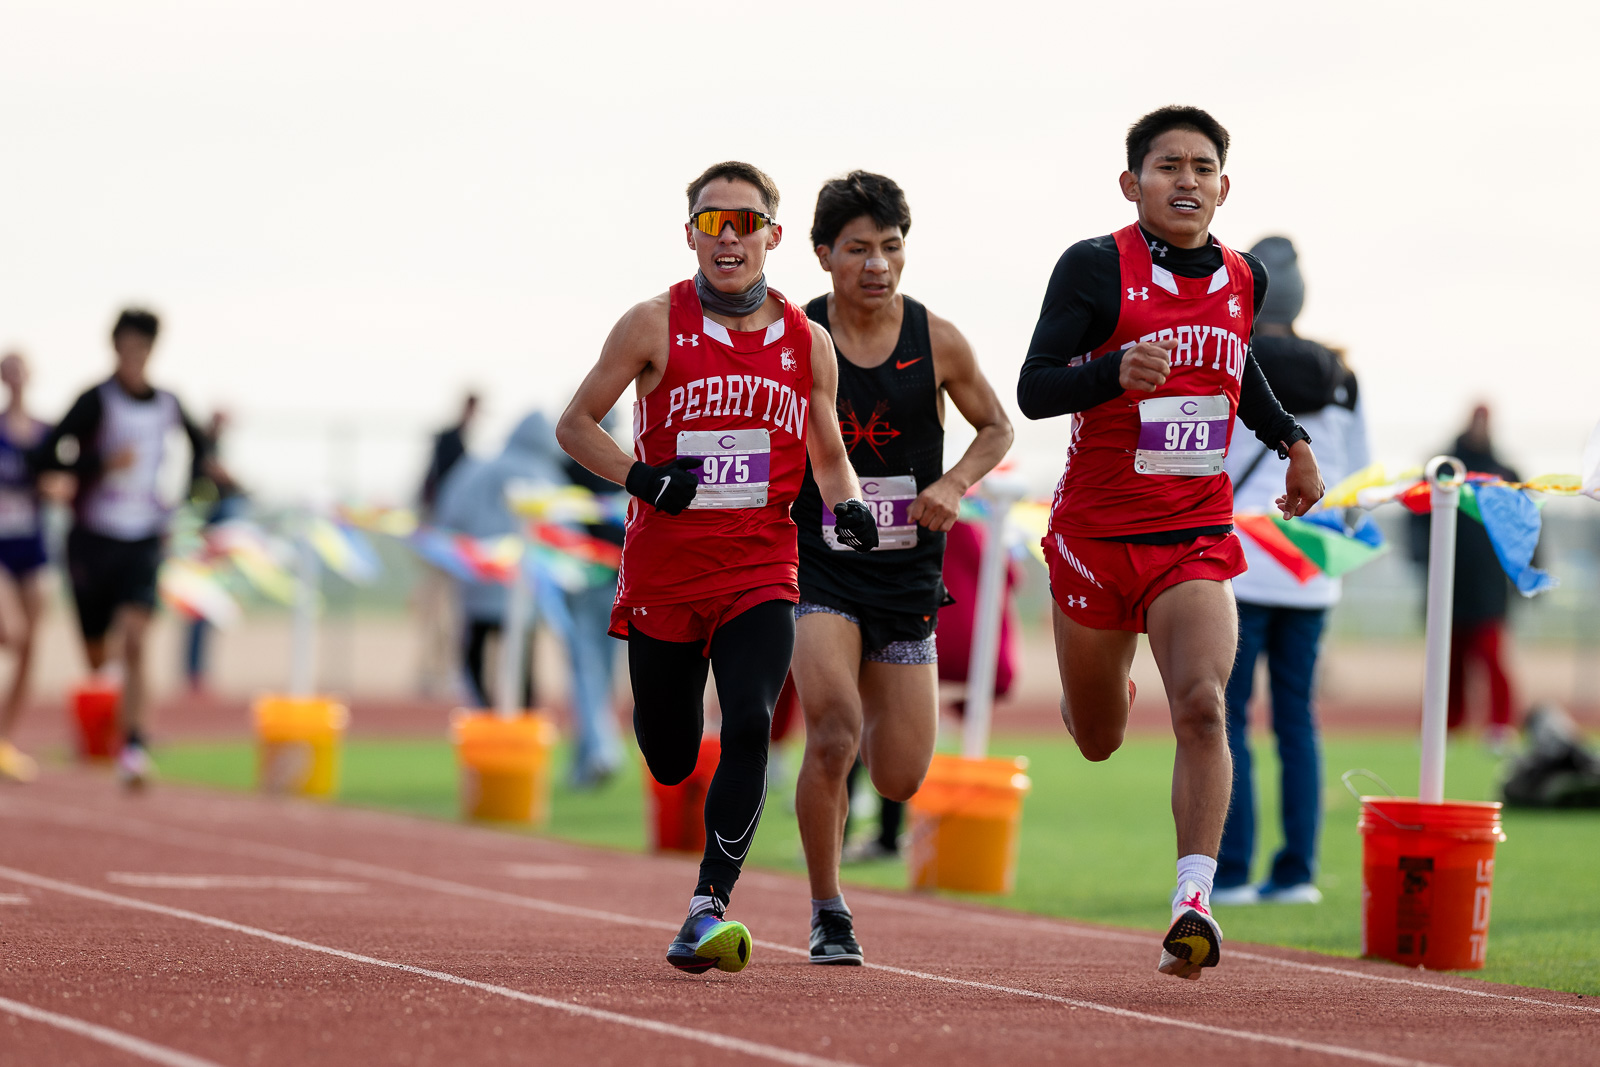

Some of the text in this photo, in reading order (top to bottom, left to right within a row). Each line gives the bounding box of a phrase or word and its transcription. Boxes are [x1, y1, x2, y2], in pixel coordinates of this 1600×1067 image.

[664, 374, 807, 440] PERRYTON
[1164, 422, 1210, 450] 979
[703, 455, 750, 484] 975
